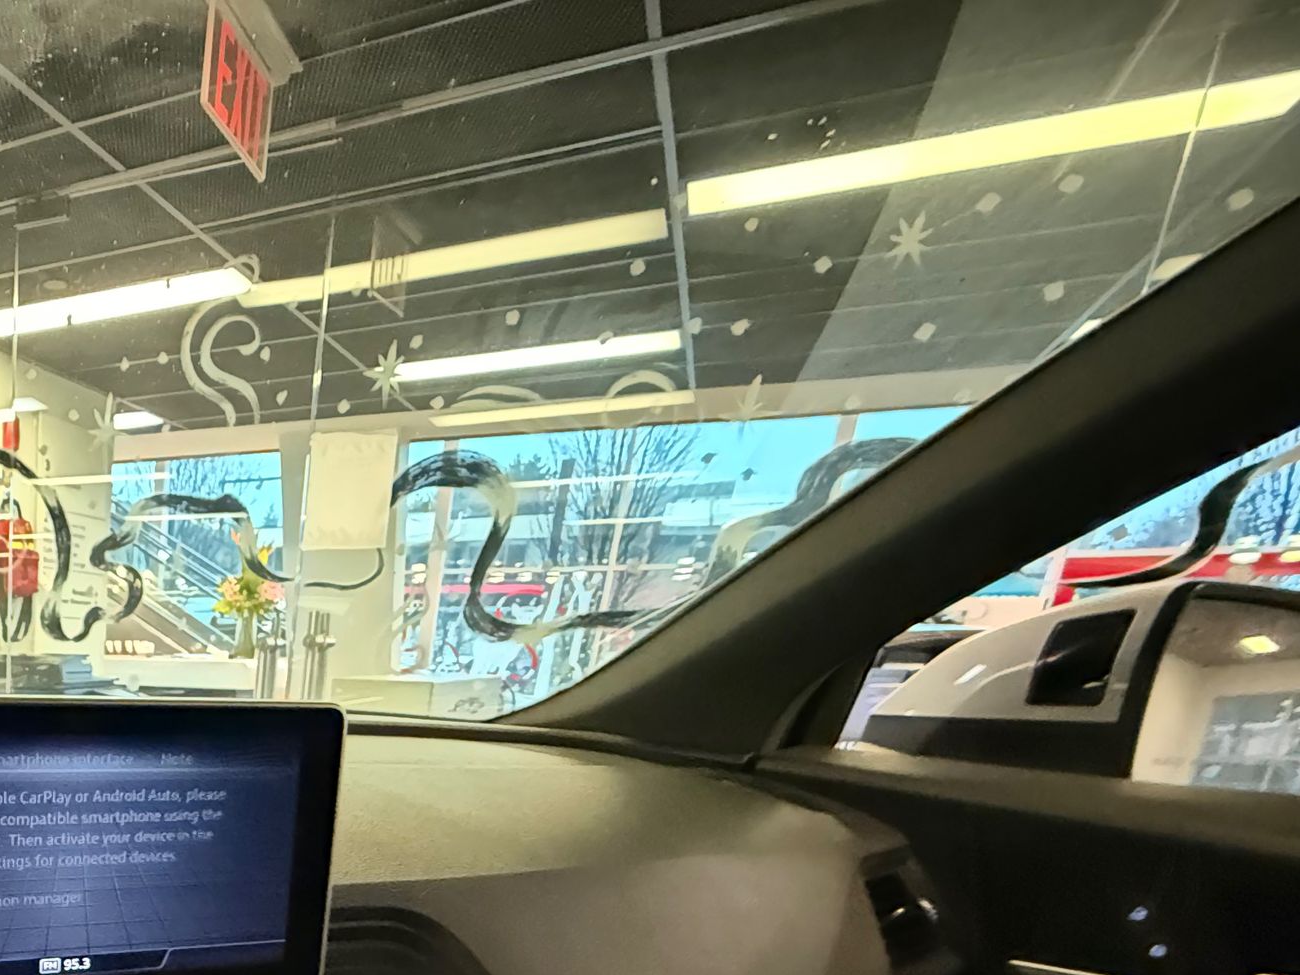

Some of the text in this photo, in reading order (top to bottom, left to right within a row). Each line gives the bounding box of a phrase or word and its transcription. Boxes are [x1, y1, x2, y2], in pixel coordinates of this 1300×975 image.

[213, 19, 268, 162] EXIT
[19, 790, 71, 806] CarPlay
[75, 792, 89, 803] or
[92, 789, 146, 802] Android
[148, 789, 182, 802] Auto,
[185, 788, 227, 803] please
[0, 811, 79, 828] compatible
[81, 808, 161, 826] smartphone
[164, 810, 200, 824] using
[202, 809, 223, 821] the
[8, 834, 42, 847] Then
[46, 831, 99, 846] activate
[102, 833, 131, 848] your
[134, 830, 175, 843] device
[192, 829, 214, 840] the
[35, 854, 53, 867] for
[57, 851, 127, 867] connected
[23, 892, 82, 907] manager
[63, 957, 91, 971] 95.3
